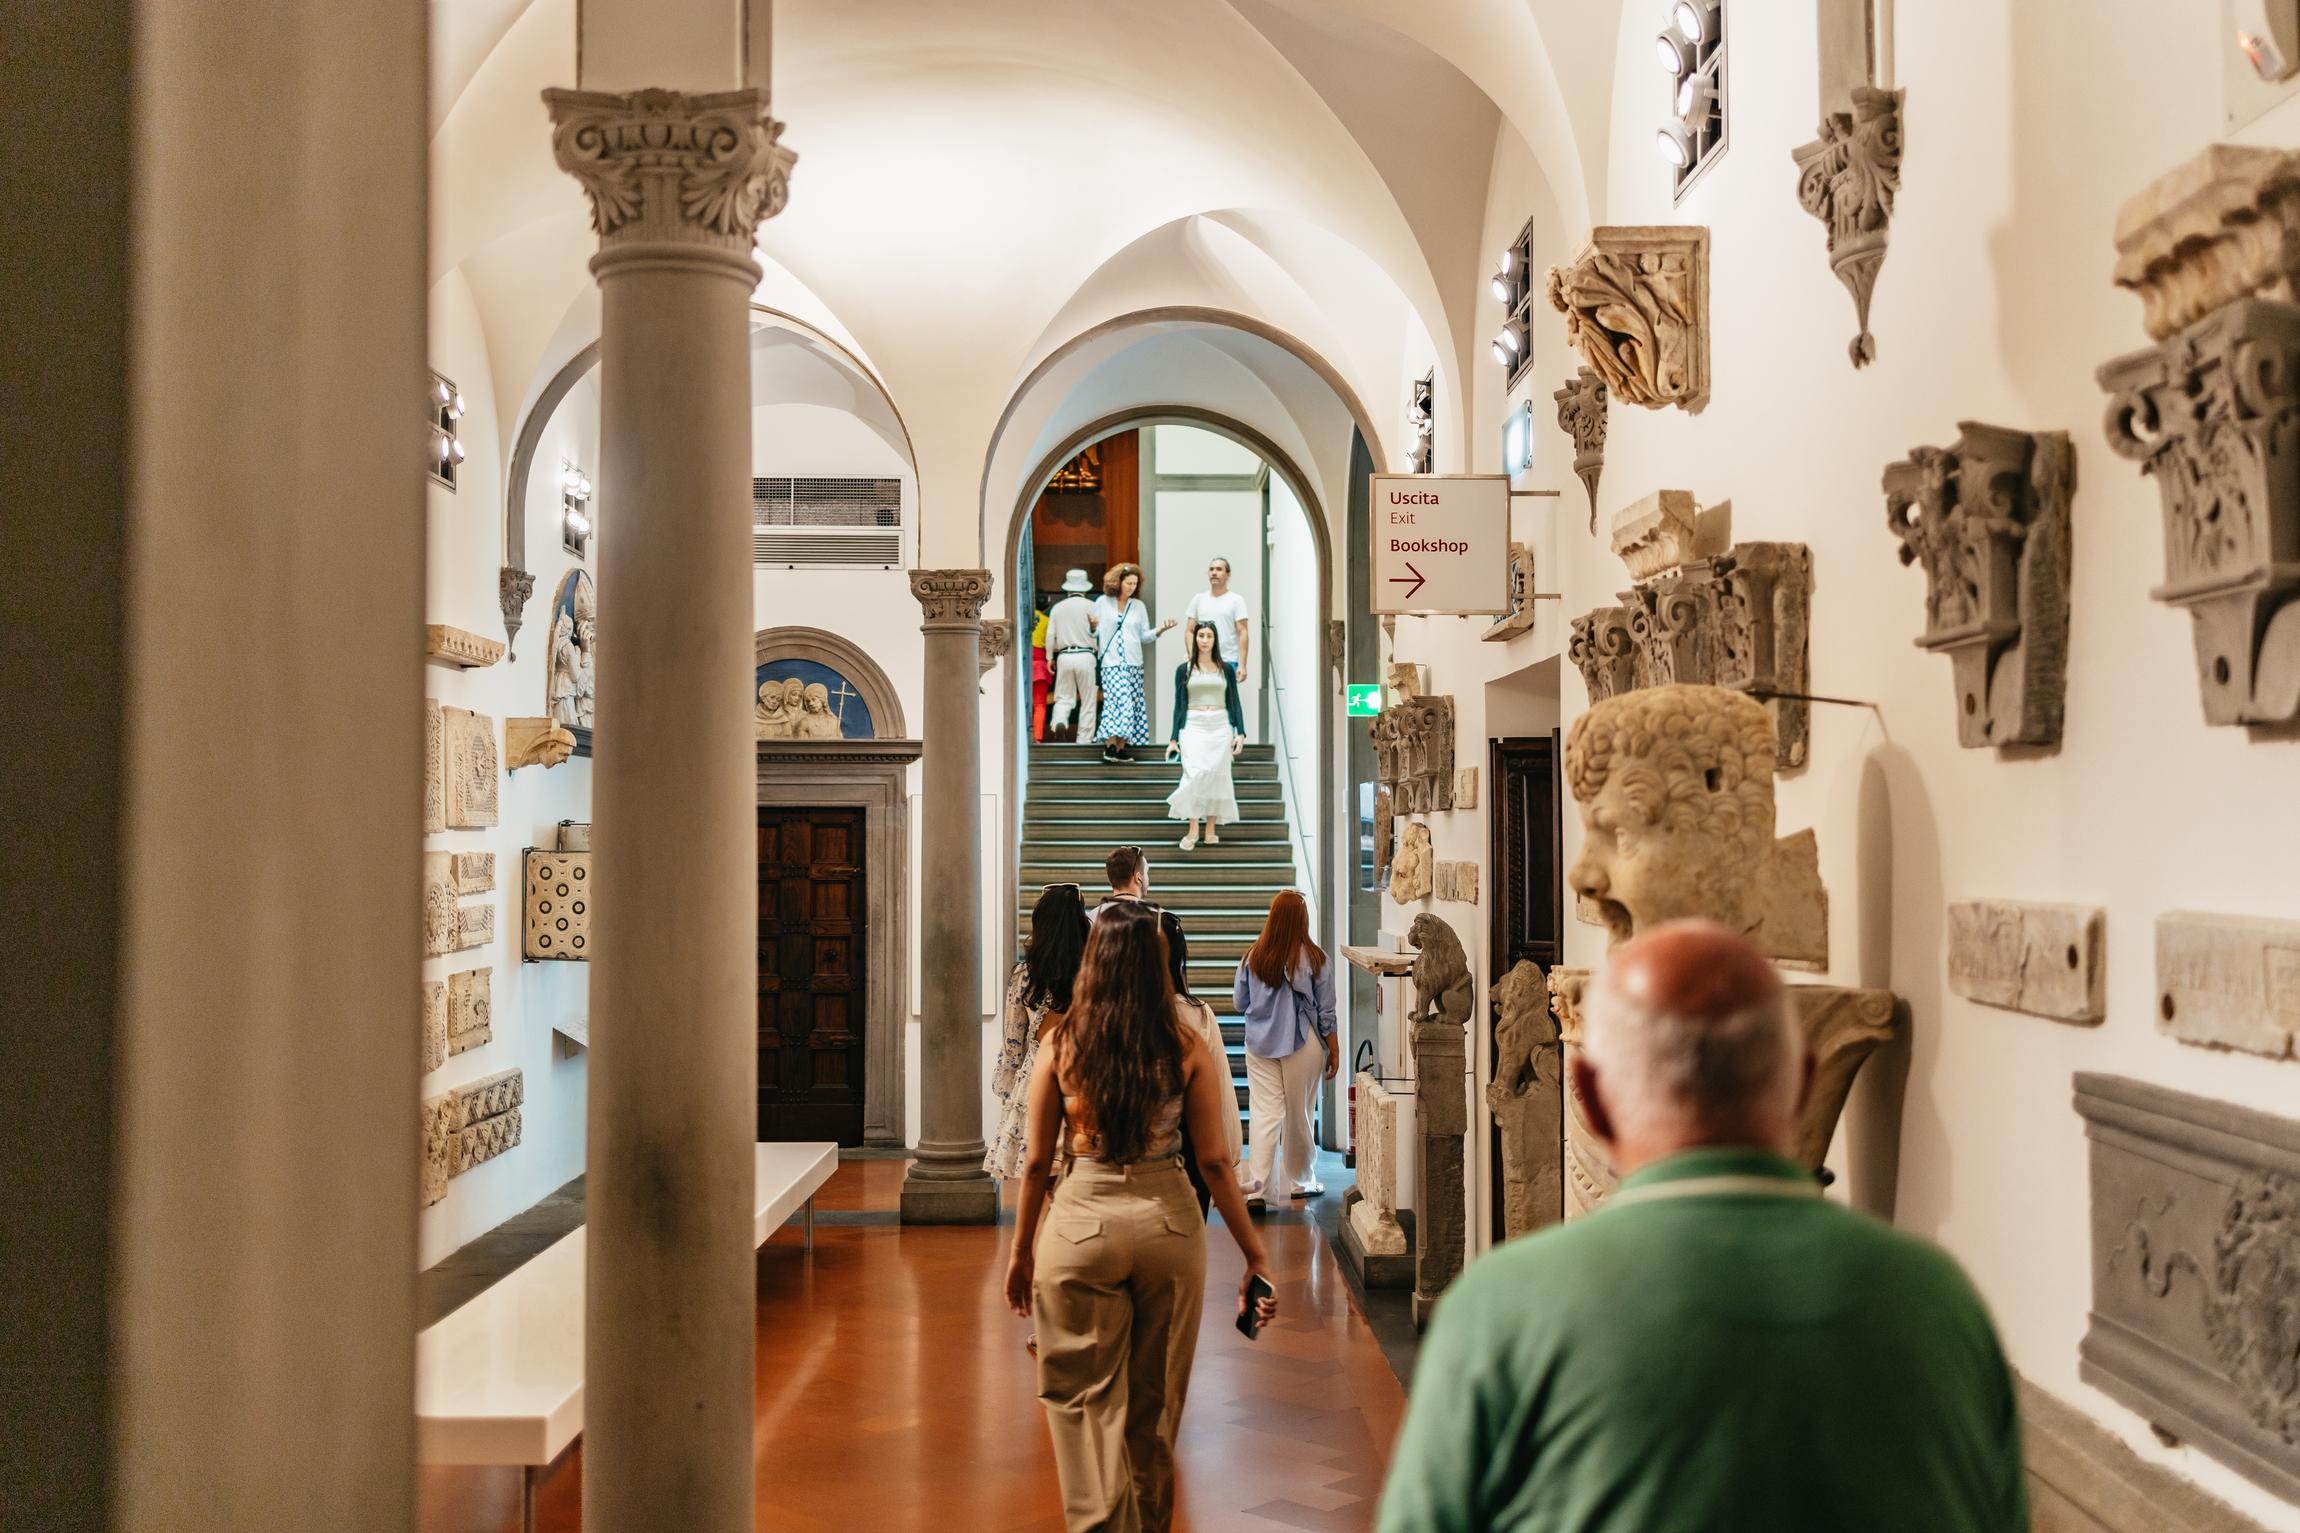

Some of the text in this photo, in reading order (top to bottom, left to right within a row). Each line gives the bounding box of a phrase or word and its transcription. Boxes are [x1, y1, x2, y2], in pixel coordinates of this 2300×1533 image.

[1390, 491, 1440, 505] Uscita
[1390, 512, 1416, 525] Exit
[1390, 539, 1469, 556] Bookshop
